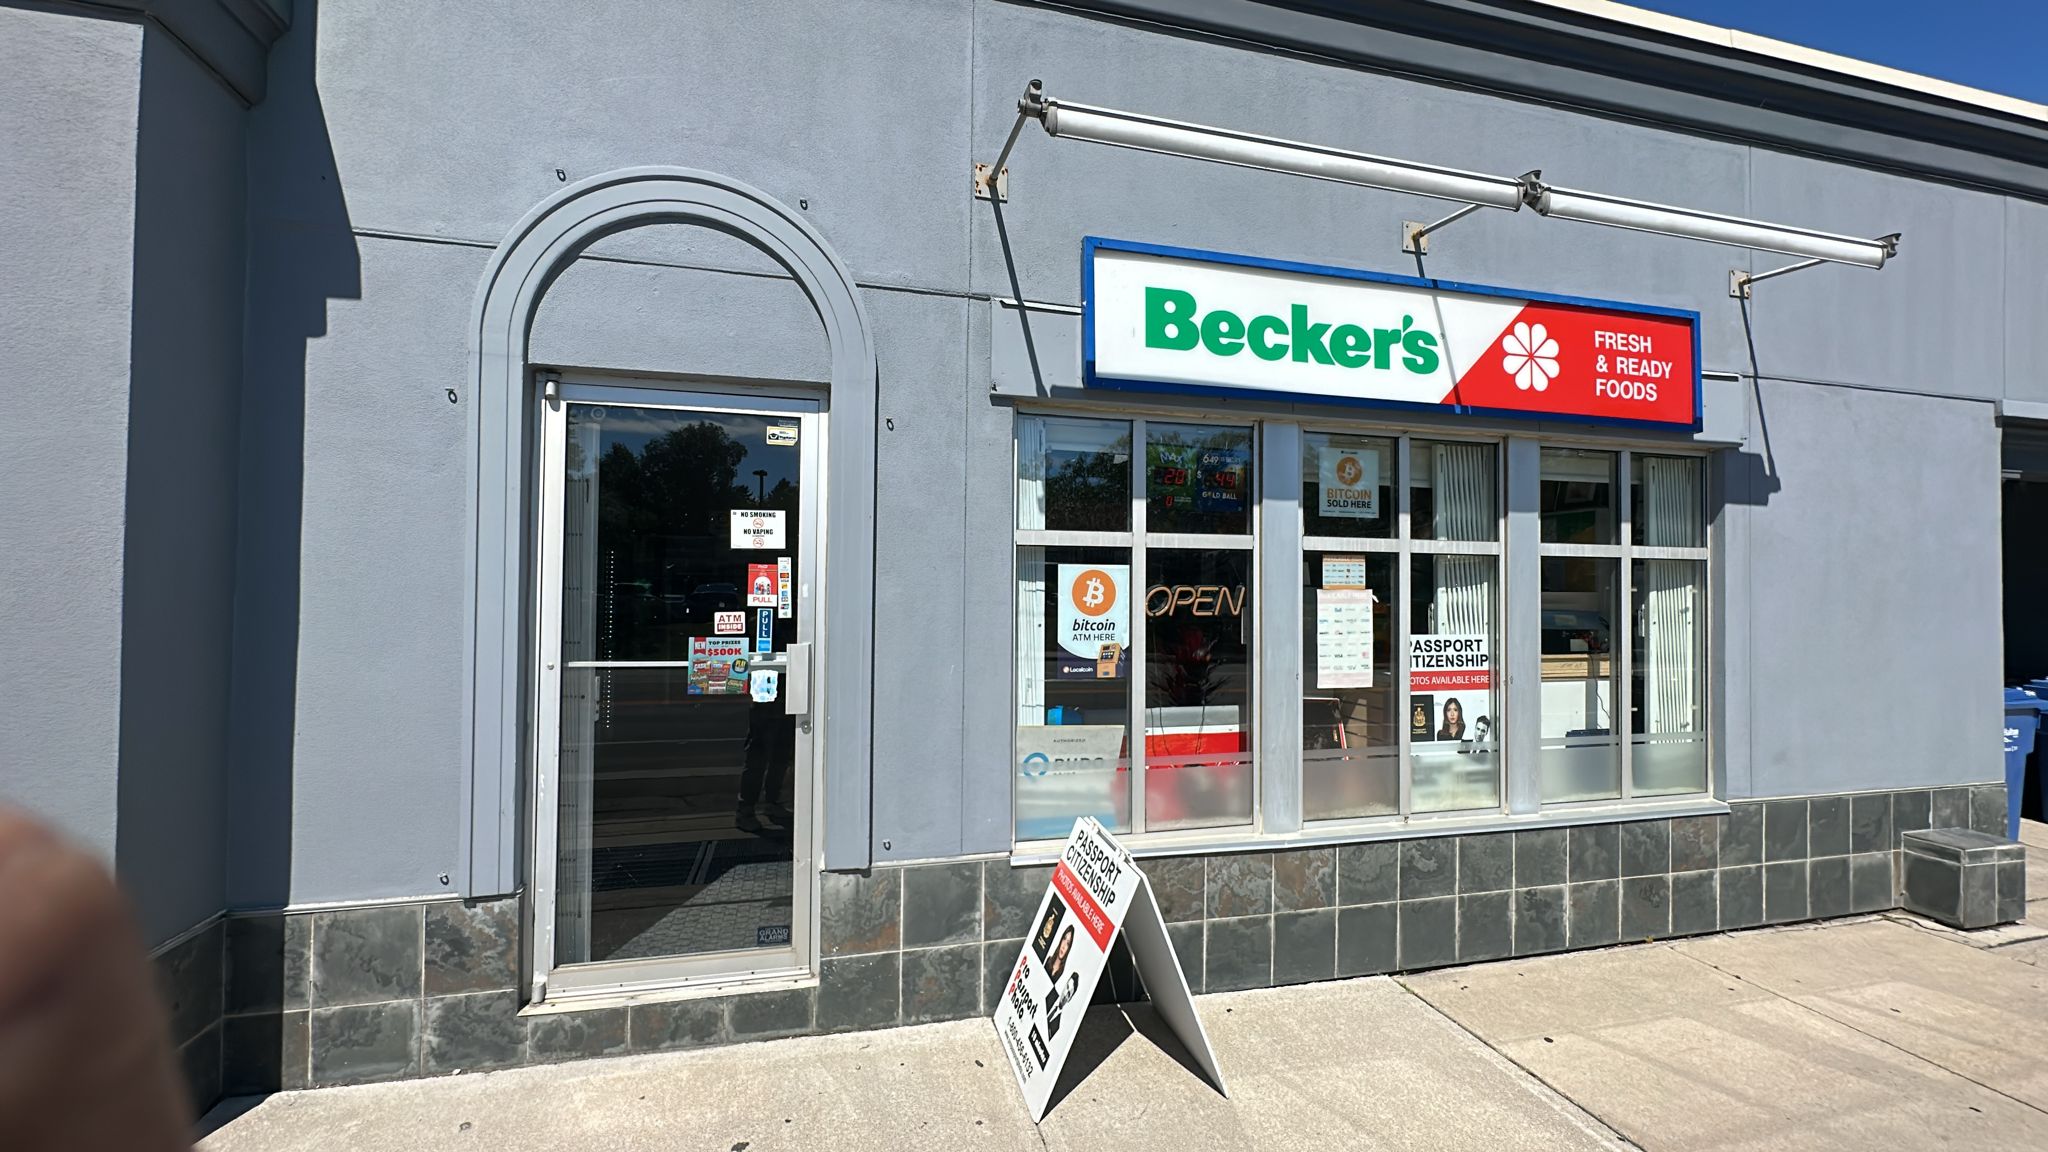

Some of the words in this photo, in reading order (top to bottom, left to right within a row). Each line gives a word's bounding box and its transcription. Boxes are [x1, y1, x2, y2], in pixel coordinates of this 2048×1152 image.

[1145, 286, 1439, 375] Becker's
[1593, 330, 1652, 354] FRESH
[1595, 355, 1607, 376] &
[1615, 356, 1673, 381] READY
[1595, 378, 1658, 402] FOODS
[1327, 488, 1372, 500] BITCOIN
[1327, 499, 1349, 508] SOLD
[1351, 500, 1372, 509] HERE
[1145, 585, 1246, 617] OPEN
[718, 614, 742, 623] ATM
[718, 623, 742, 631] INSIDE
[1073, 619, 1116, 632] bitcoin
[1072, 633, 1091, 642] ATM
[1093, 633, 1116, 641] HERE
[1410, 639, 1483, 653] ASSPORT
[707, 648, 742, 656] $500K
[1431, 676, 1469, 685] AVAILABLE
[1471, 675, 1490, 683] HERE
[1075, 829, 1122, 886] PASSPORT
[1066, 845, 1116, 908] CITIZENSHIP
[759, 928, 789, 936] GRAND
[1020, 955, 1030, 980] Pro
[1008, 982, 1024, 1020] Photo
[1014, 969, 1038, 1020] Passport
